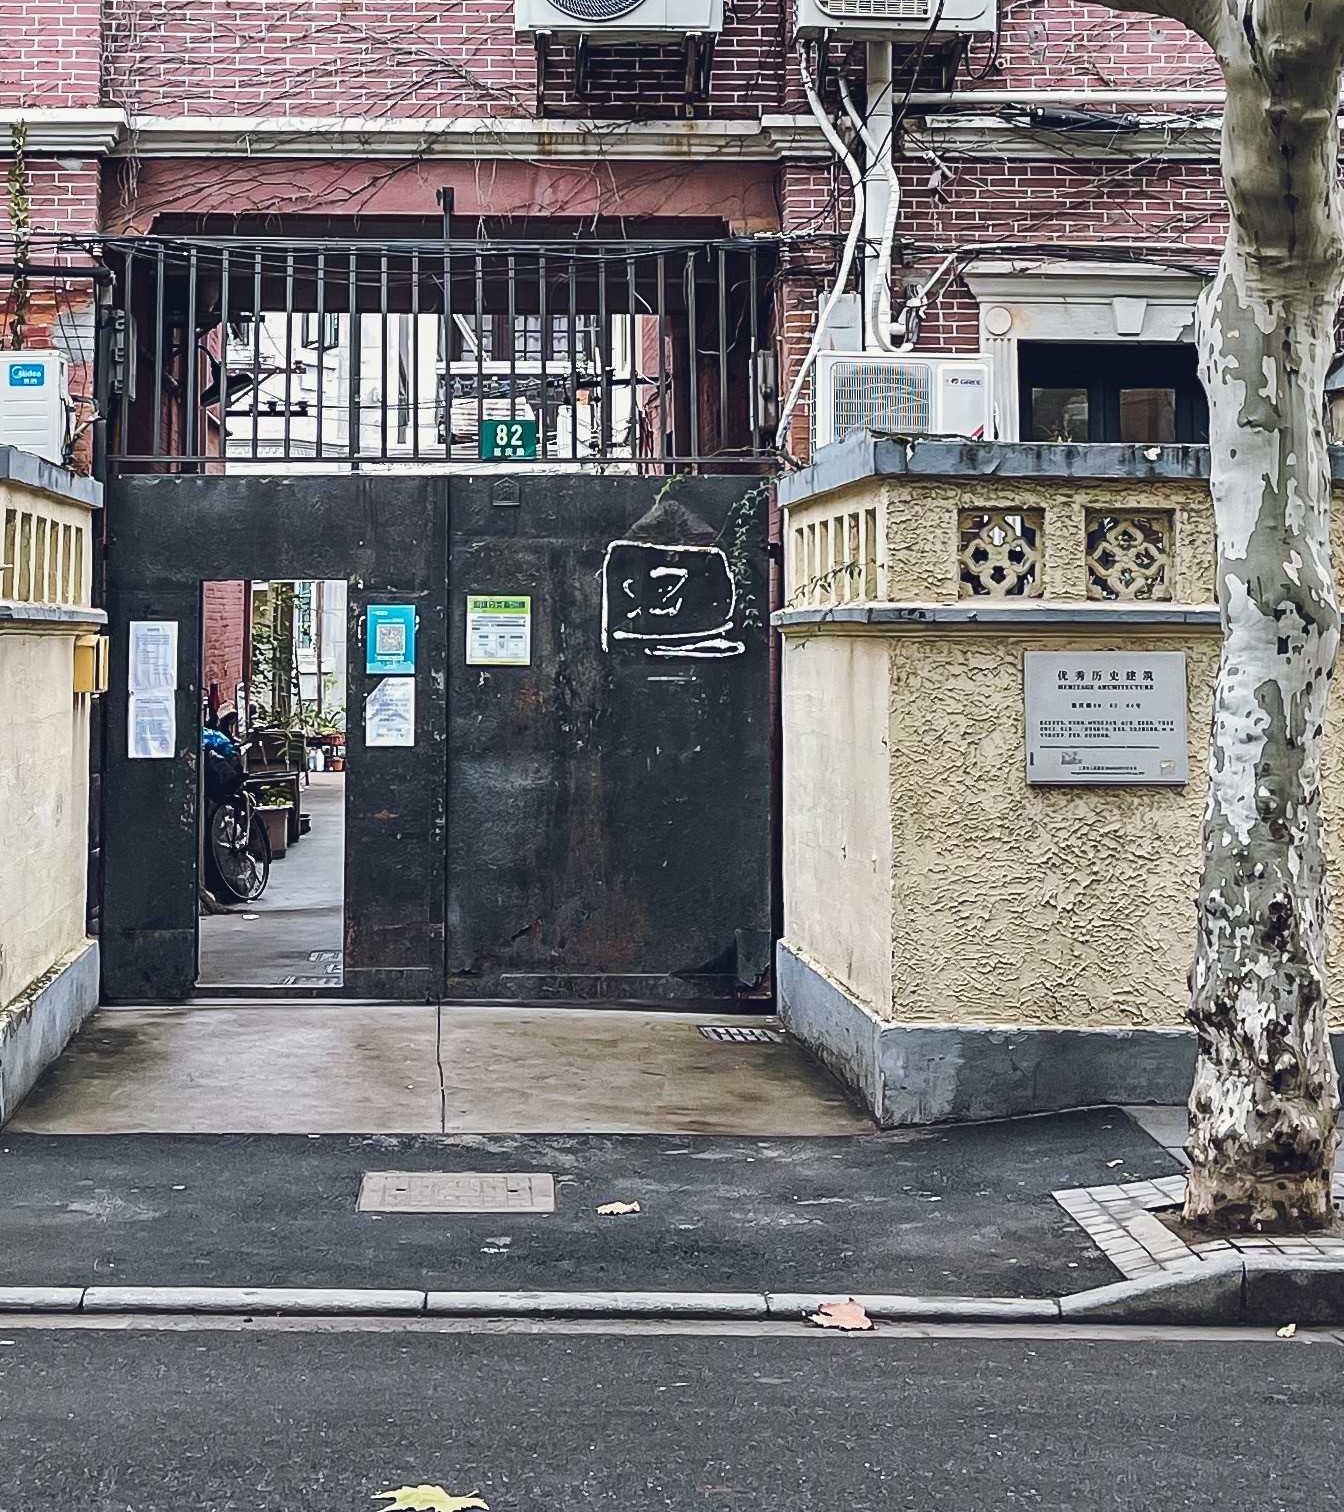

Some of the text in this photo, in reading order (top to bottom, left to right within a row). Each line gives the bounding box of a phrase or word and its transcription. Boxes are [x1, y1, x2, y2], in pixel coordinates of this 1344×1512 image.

[15, 367, 42, 378] Midea
[496, 424, 523, 446] 82
[1057, 670, 1154, 682] 优秀历史建筑
